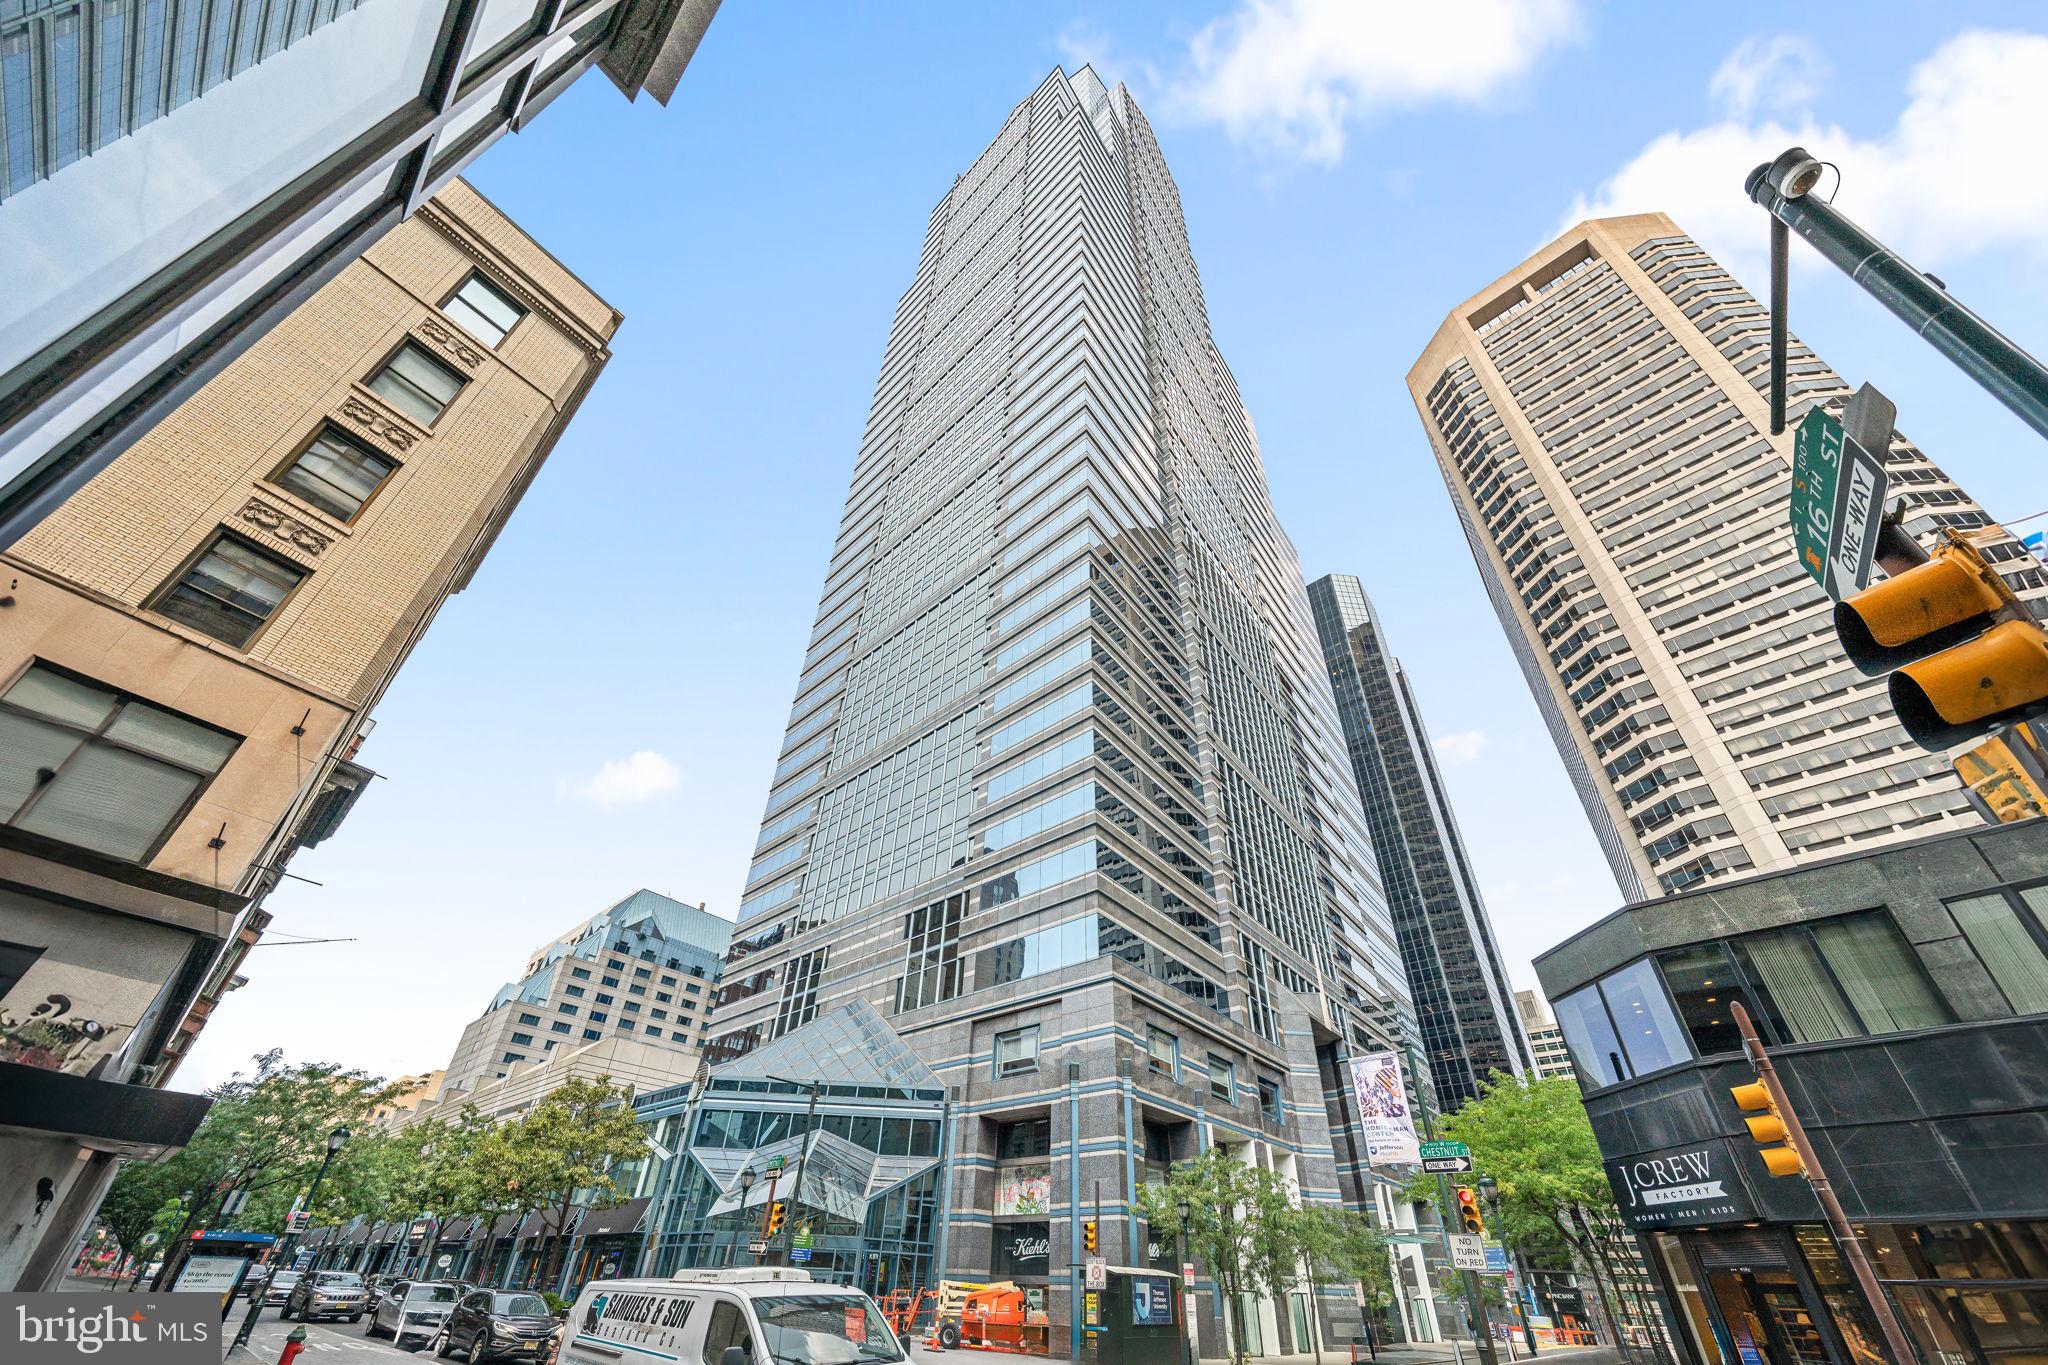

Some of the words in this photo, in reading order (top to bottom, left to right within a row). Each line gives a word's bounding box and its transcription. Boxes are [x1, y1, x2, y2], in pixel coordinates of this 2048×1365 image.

[1820, 423, 1840, 469] ST
[1797, 444, 1808, 472] 100
[1848, 466, 1871, 528] WAY
[1841, 523, 1861, 575] ONE
[1421, 1146, 1459, 1157] CHESTNUT
[1461, 1148, 1468, 1156] ST
[1619, 1150, 1710, 1207] J.CREW
[1655, 1186, 1711, 1201] FACTORY
[1634, 1212, 1669, 1222] WOMEN
[1678, 1209, 1698, 1218] MEN
[1710, 1205, 1736, 1215] KIDS
[1012, 1237, 1050, 1256] Kiehl's
[1458, 1238, 1472, 1246] NO
[1456, 1248, 1480, 1256] TURN
[1469, 1258, 1484, 1268] RED
[603, 1293, 657, 1324] SAMUELS
[650, 1298, 667, 1325] &
[661, 1298, 696, 1329] SON
